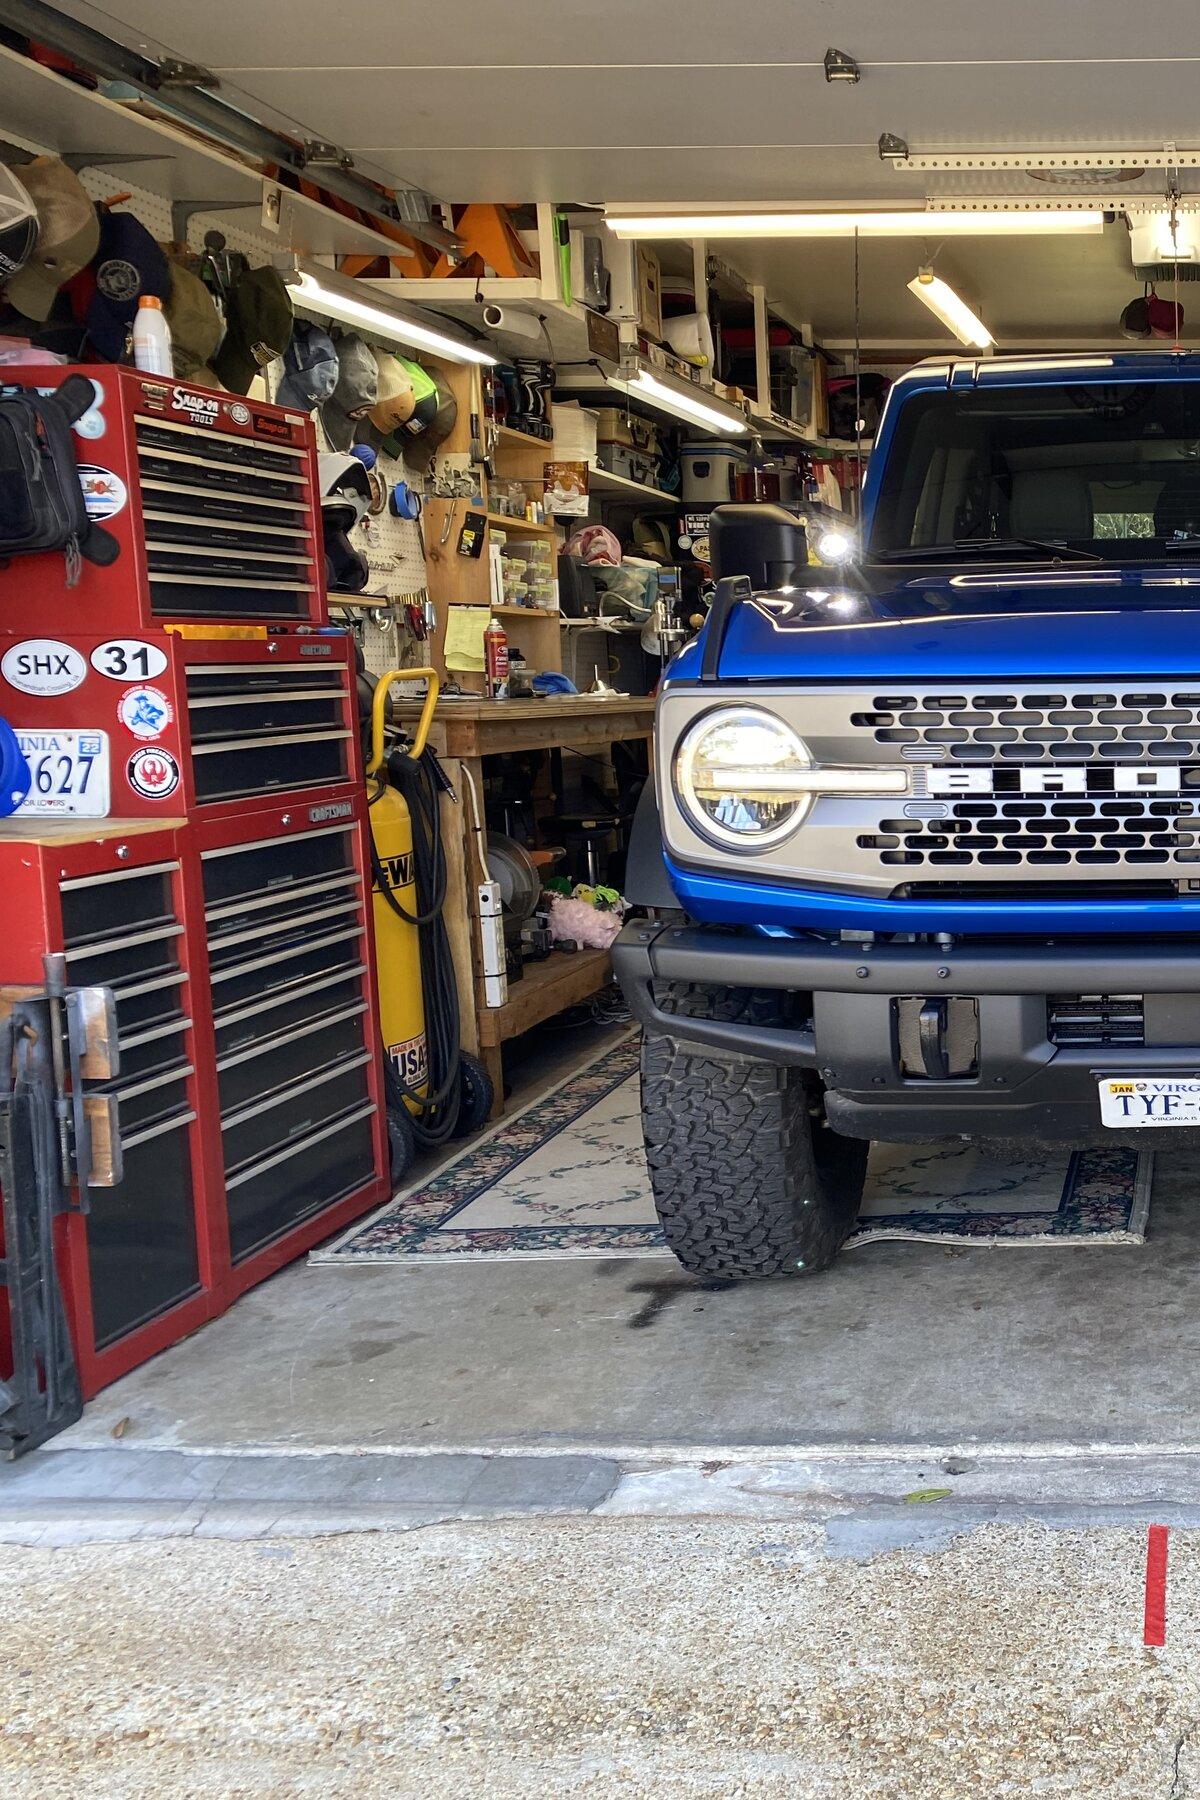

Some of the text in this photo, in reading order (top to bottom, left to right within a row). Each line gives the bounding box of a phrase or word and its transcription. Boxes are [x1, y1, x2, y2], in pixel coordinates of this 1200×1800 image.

[190, 412, 215, 425] TOOLS
[17, 655, 71, 675] SHX
[104, 646, 150, 676] 31
[19, 736, 99, 753] INIA 22
[23, 755, 95, 794] 627
[392, 1046, 426, 1079] USA
